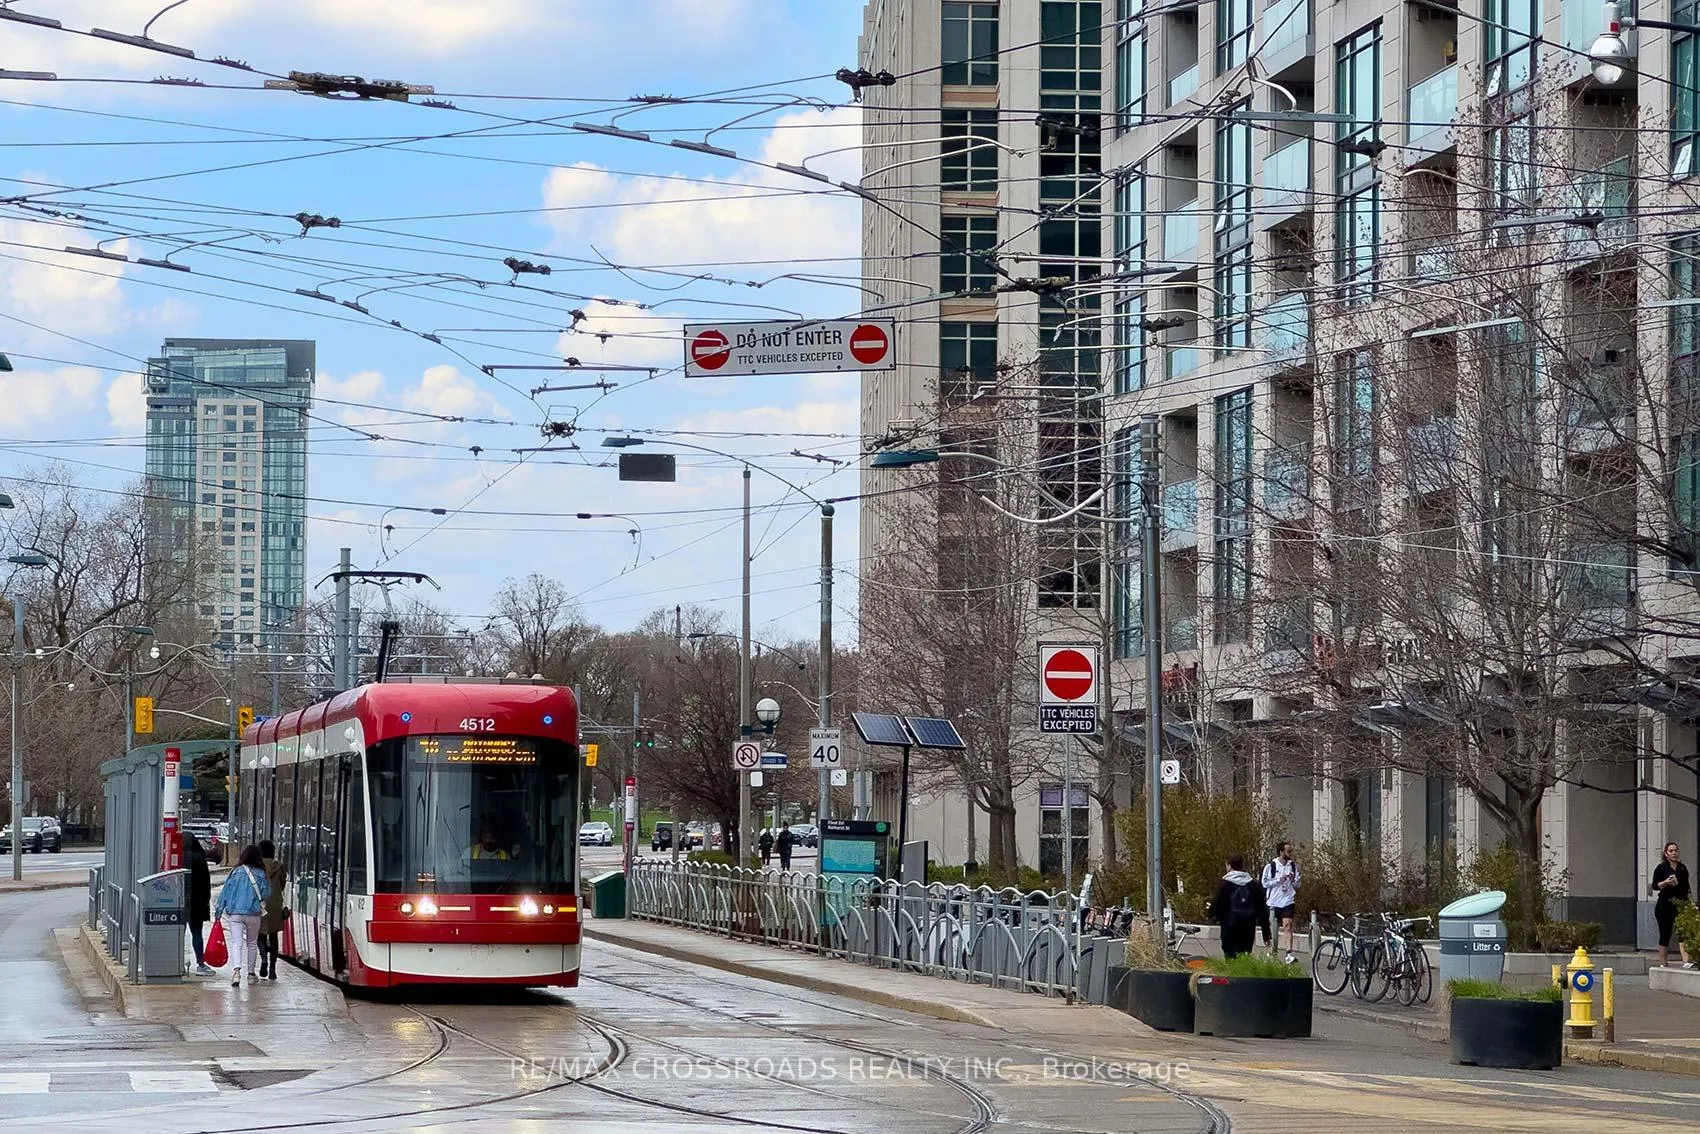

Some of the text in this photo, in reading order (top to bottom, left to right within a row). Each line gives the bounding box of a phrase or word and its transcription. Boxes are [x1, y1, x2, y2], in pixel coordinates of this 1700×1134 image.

[736, 329, 843, 348] DO NOT ENTER
[737, 350, 843, 365] TTC VEHICLES EXCEPTED
[1041, 708, 1095, 719] TTC VEHICLES
[459, 718, 495, 731] 4512
[1043, 720, 1092, 731] EXCEPTED
[813, 745, 839, 763] 40
[149, 913, 168, 922] Litter
[1473, 942, 1491, 951] Litter
